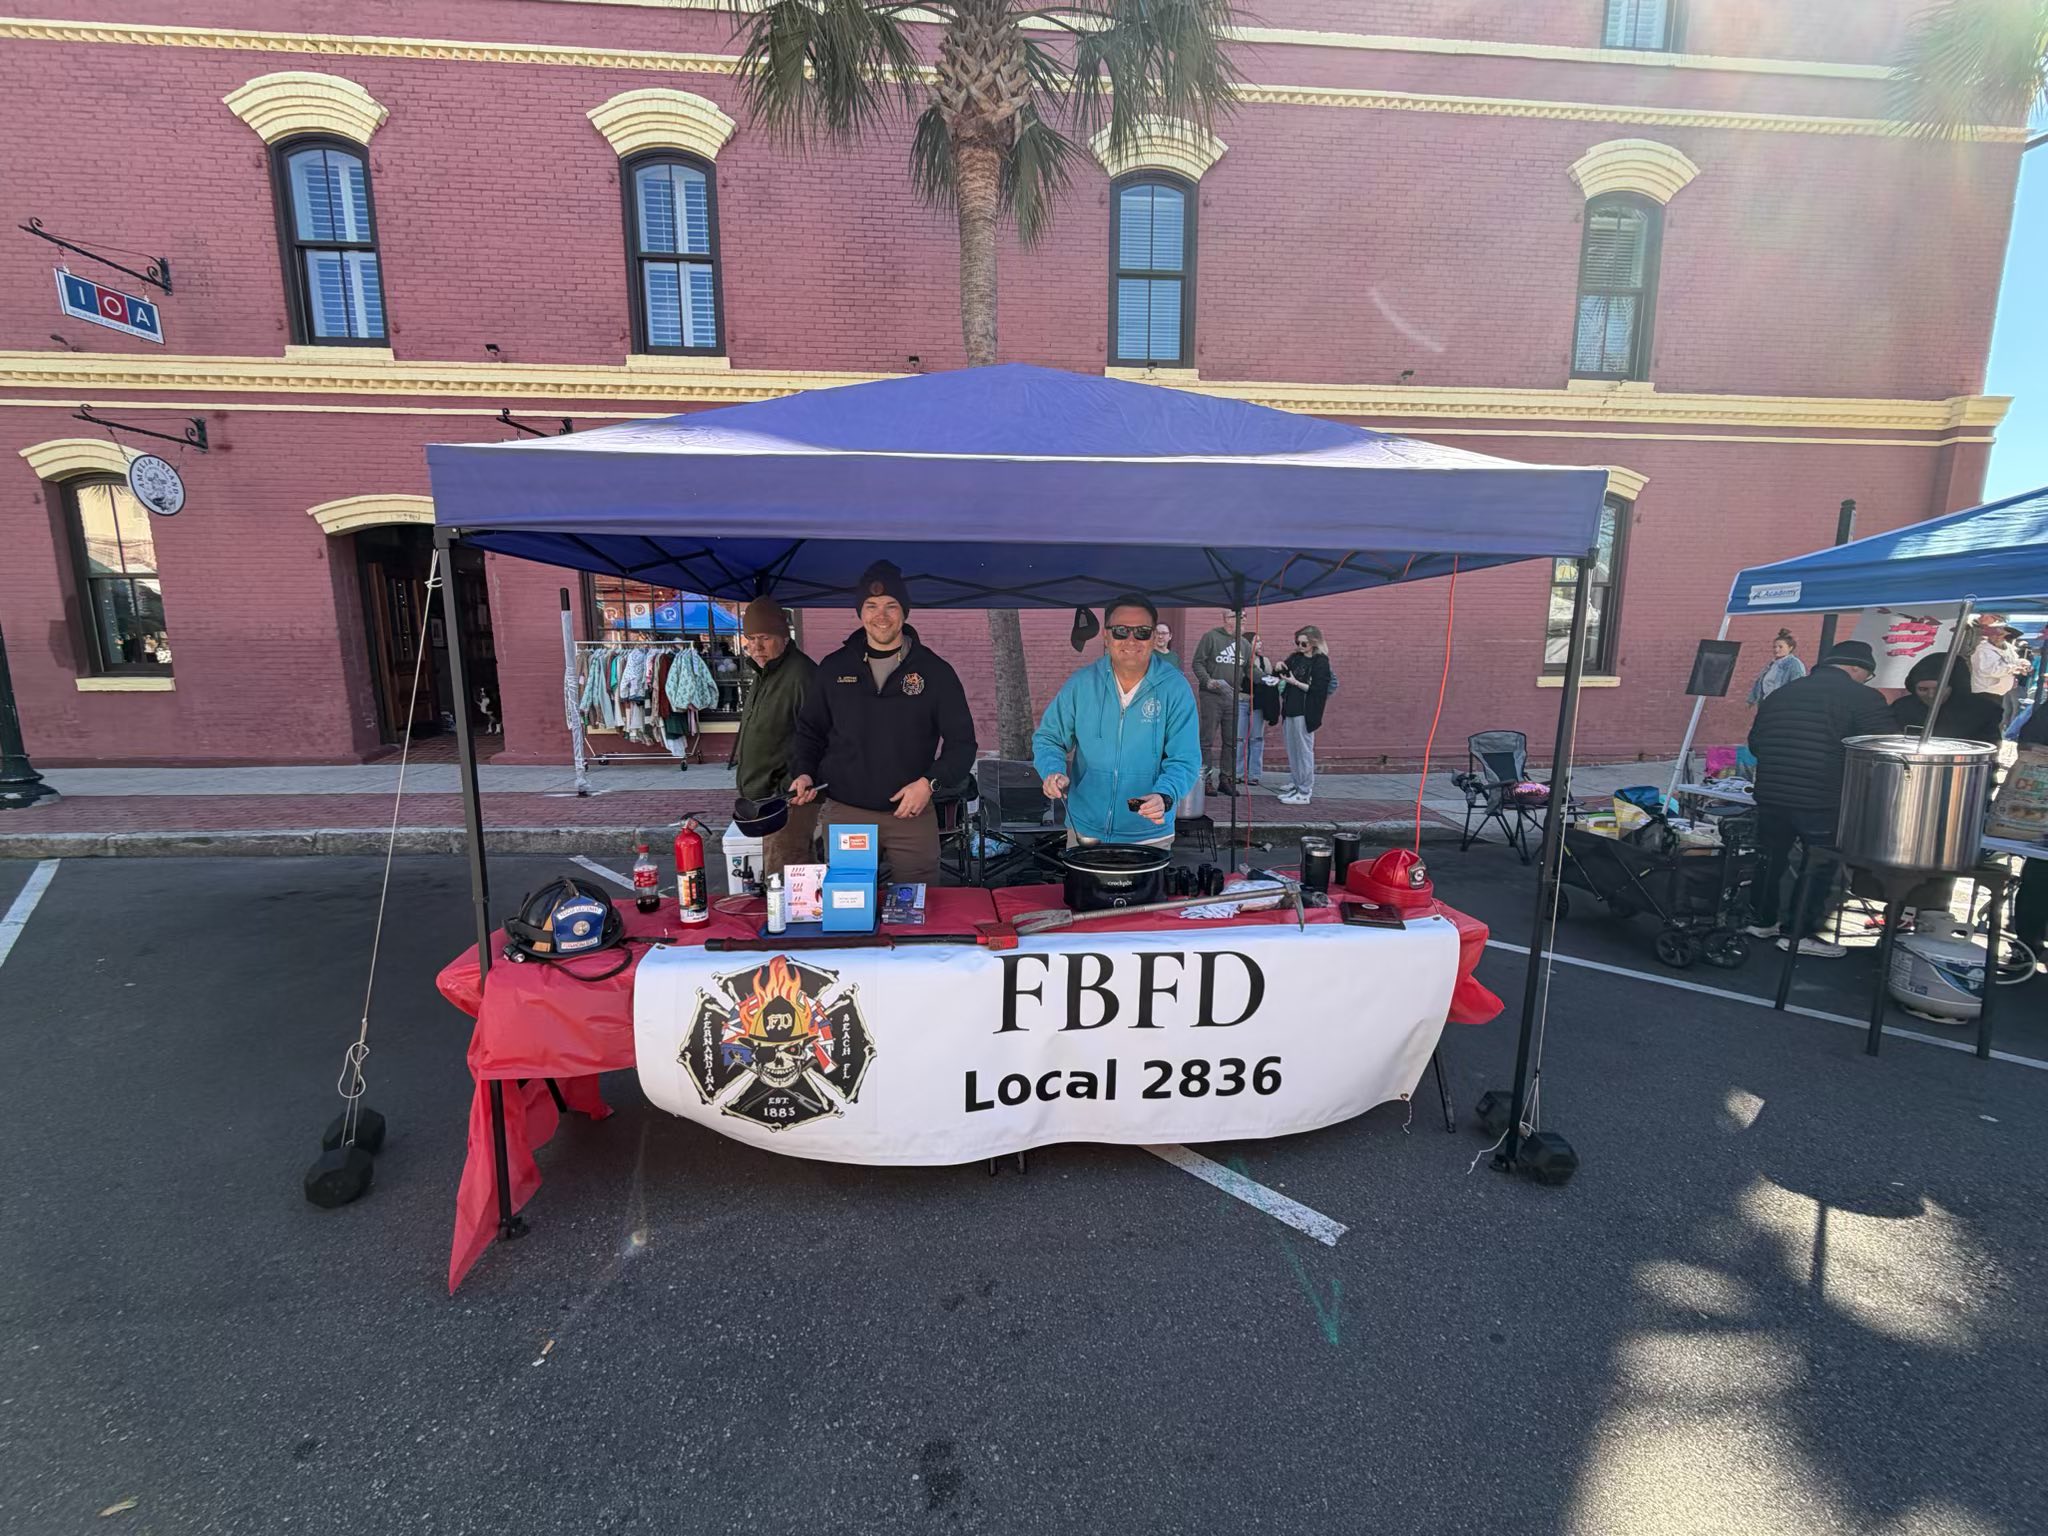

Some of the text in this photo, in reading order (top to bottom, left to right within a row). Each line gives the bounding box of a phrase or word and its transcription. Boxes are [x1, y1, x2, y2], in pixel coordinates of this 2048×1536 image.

[137, 459, 154, 489] AMELIA
[156, 461, 179, 494] ISLAND
[766, 1013, 793, 1030] FD
[992, 950, 1265, 1034] FBFD
[702, 1011, 715, 1091] FERNANDINA
[841, 1013, 851, 1080] BEACH FL
[965, 1056, 1282, 1113] Local 2836
